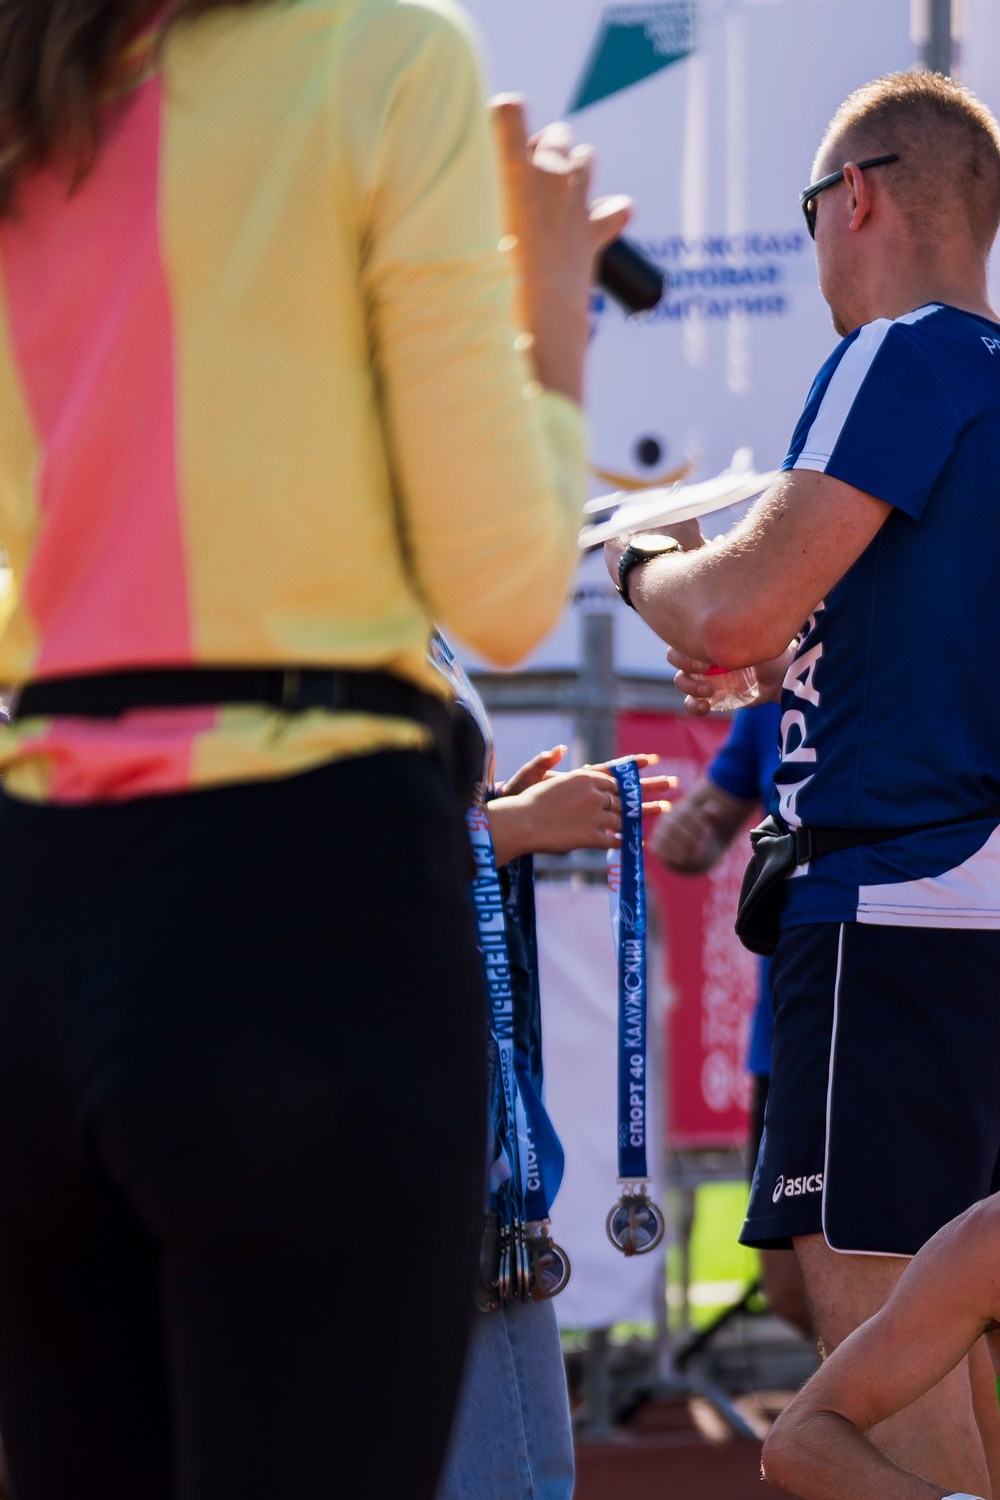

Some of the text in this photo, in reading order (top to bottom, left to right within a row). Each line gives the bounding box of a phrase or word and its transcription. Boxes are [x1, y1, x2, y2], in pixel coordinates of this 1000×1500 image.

[479, 929, 516, 1040] ПЕРВЫМ
[622, 938, 643, 1049] КАЛУЖСКИЙ
[500, 1048, 514, 1115] СПОРТ
[629, 1053, 644, 1080] 40
[629, 1082, 644, 1148] СПОРТ
[784, 1173, 823, 1197] asics
